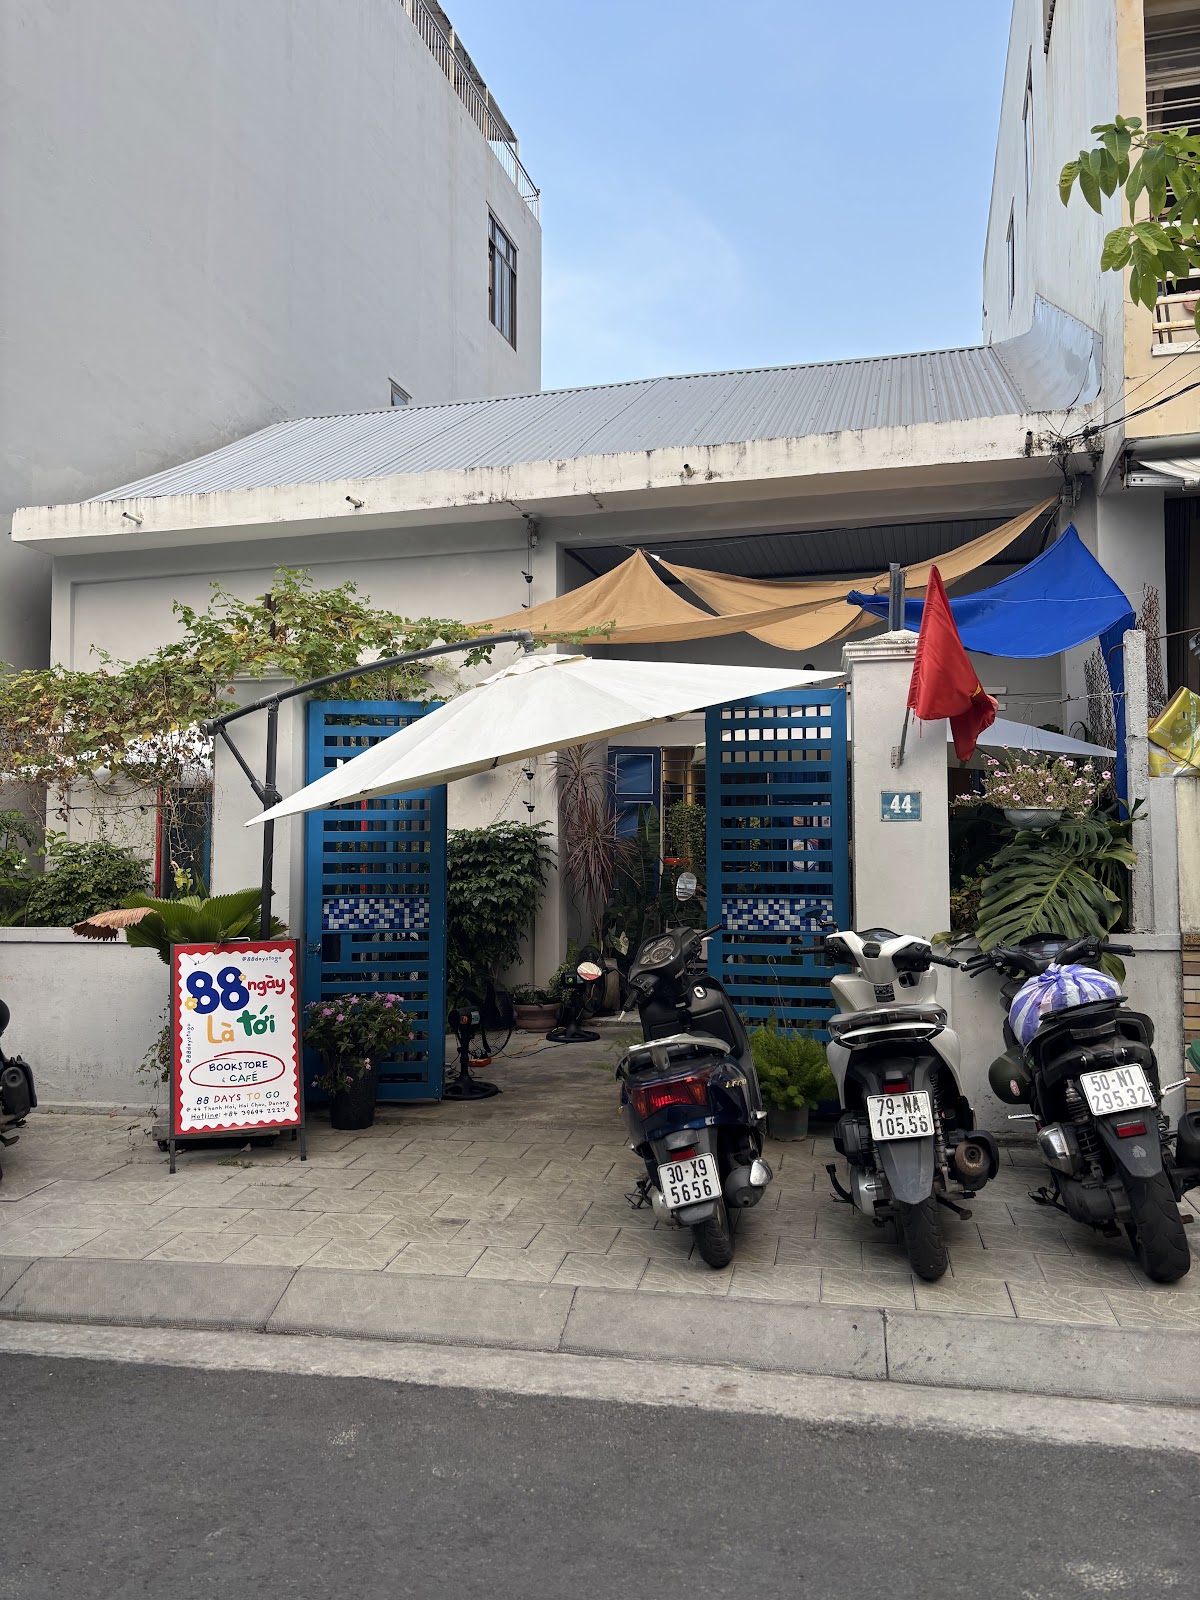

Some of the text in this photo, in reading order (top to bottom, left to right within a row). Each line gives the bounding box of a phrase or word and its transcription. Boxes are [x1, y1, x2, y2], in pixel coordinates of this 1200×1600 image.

[890, 795, 912, 813] 44
[186, 967, 285, 1014] 88 ngày
[207, 1005, 275, 1043] Là tới
[208, 1060, 268, 1071] BOOKSTORE
[229, 1070, 258, 1082] CAFÉ
[1090, 1069, 1135, 1092] 50-N1
[196, 1091, 280, 1105] 88 DAYS TO GO
[877, 1095, 920, 1116] 79-NA
[1091, 1086, 1150, 1112] 295.32
[666, 1159, 708, 1184] 30-X9
[671, 1179, 712, 1204] 5656
